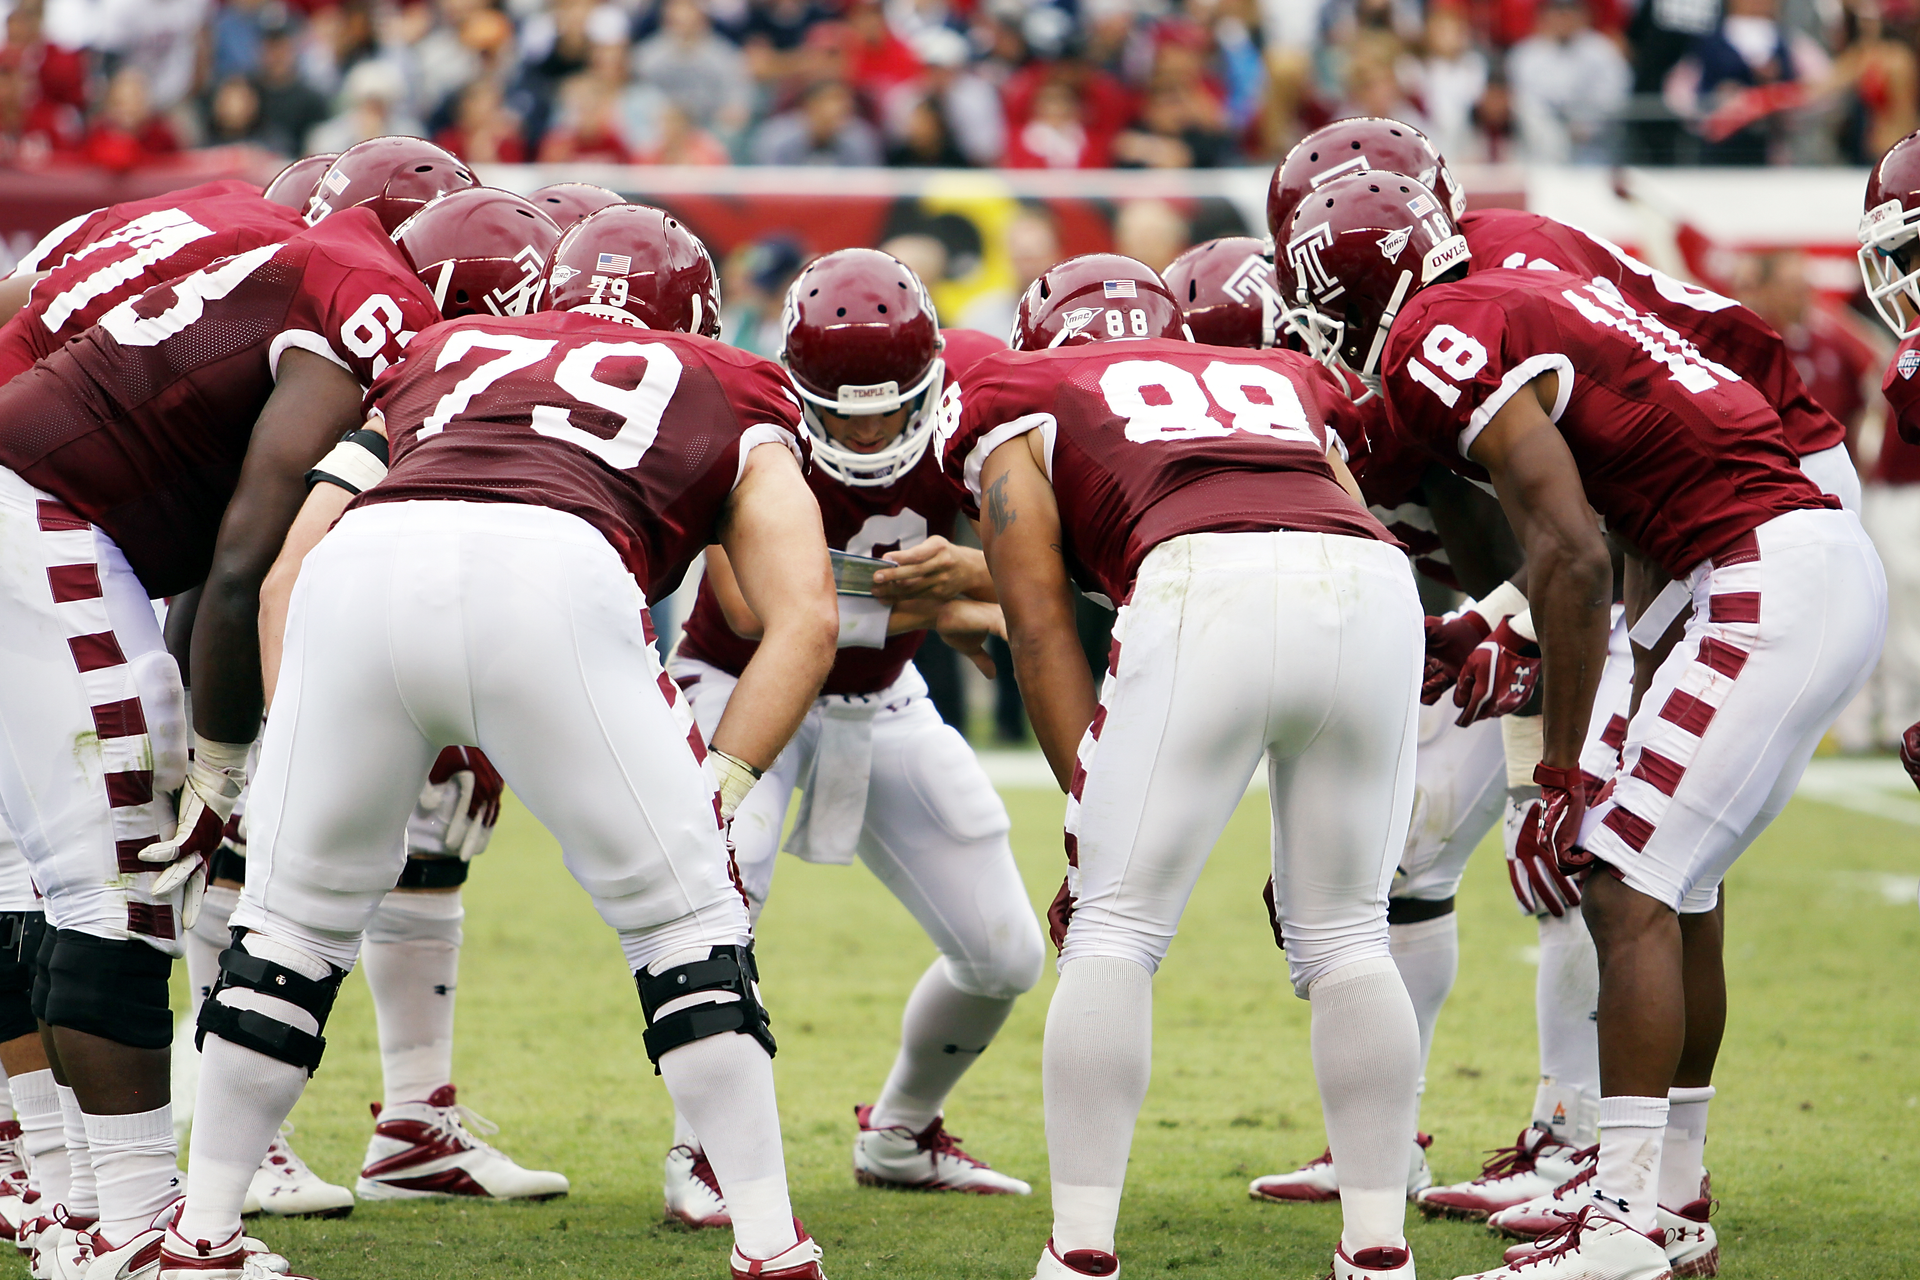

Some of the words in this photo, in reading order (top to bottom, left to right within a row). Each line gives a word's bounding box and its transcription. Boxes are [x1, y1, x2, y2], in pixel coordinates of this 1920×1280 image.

[1422, 212, 1451, 246] 18
[1432, 241, 1466, 268] OWLS
[590, 275, 629, 307] 79
[1105, 308, 1149, 337] 88
[1406, 324, 1488, 409] 18
[416, 329, 684, 470] 79
[853, 387, 885, 398] TEMPLE
[1099, 360, 1322, 447] 88
